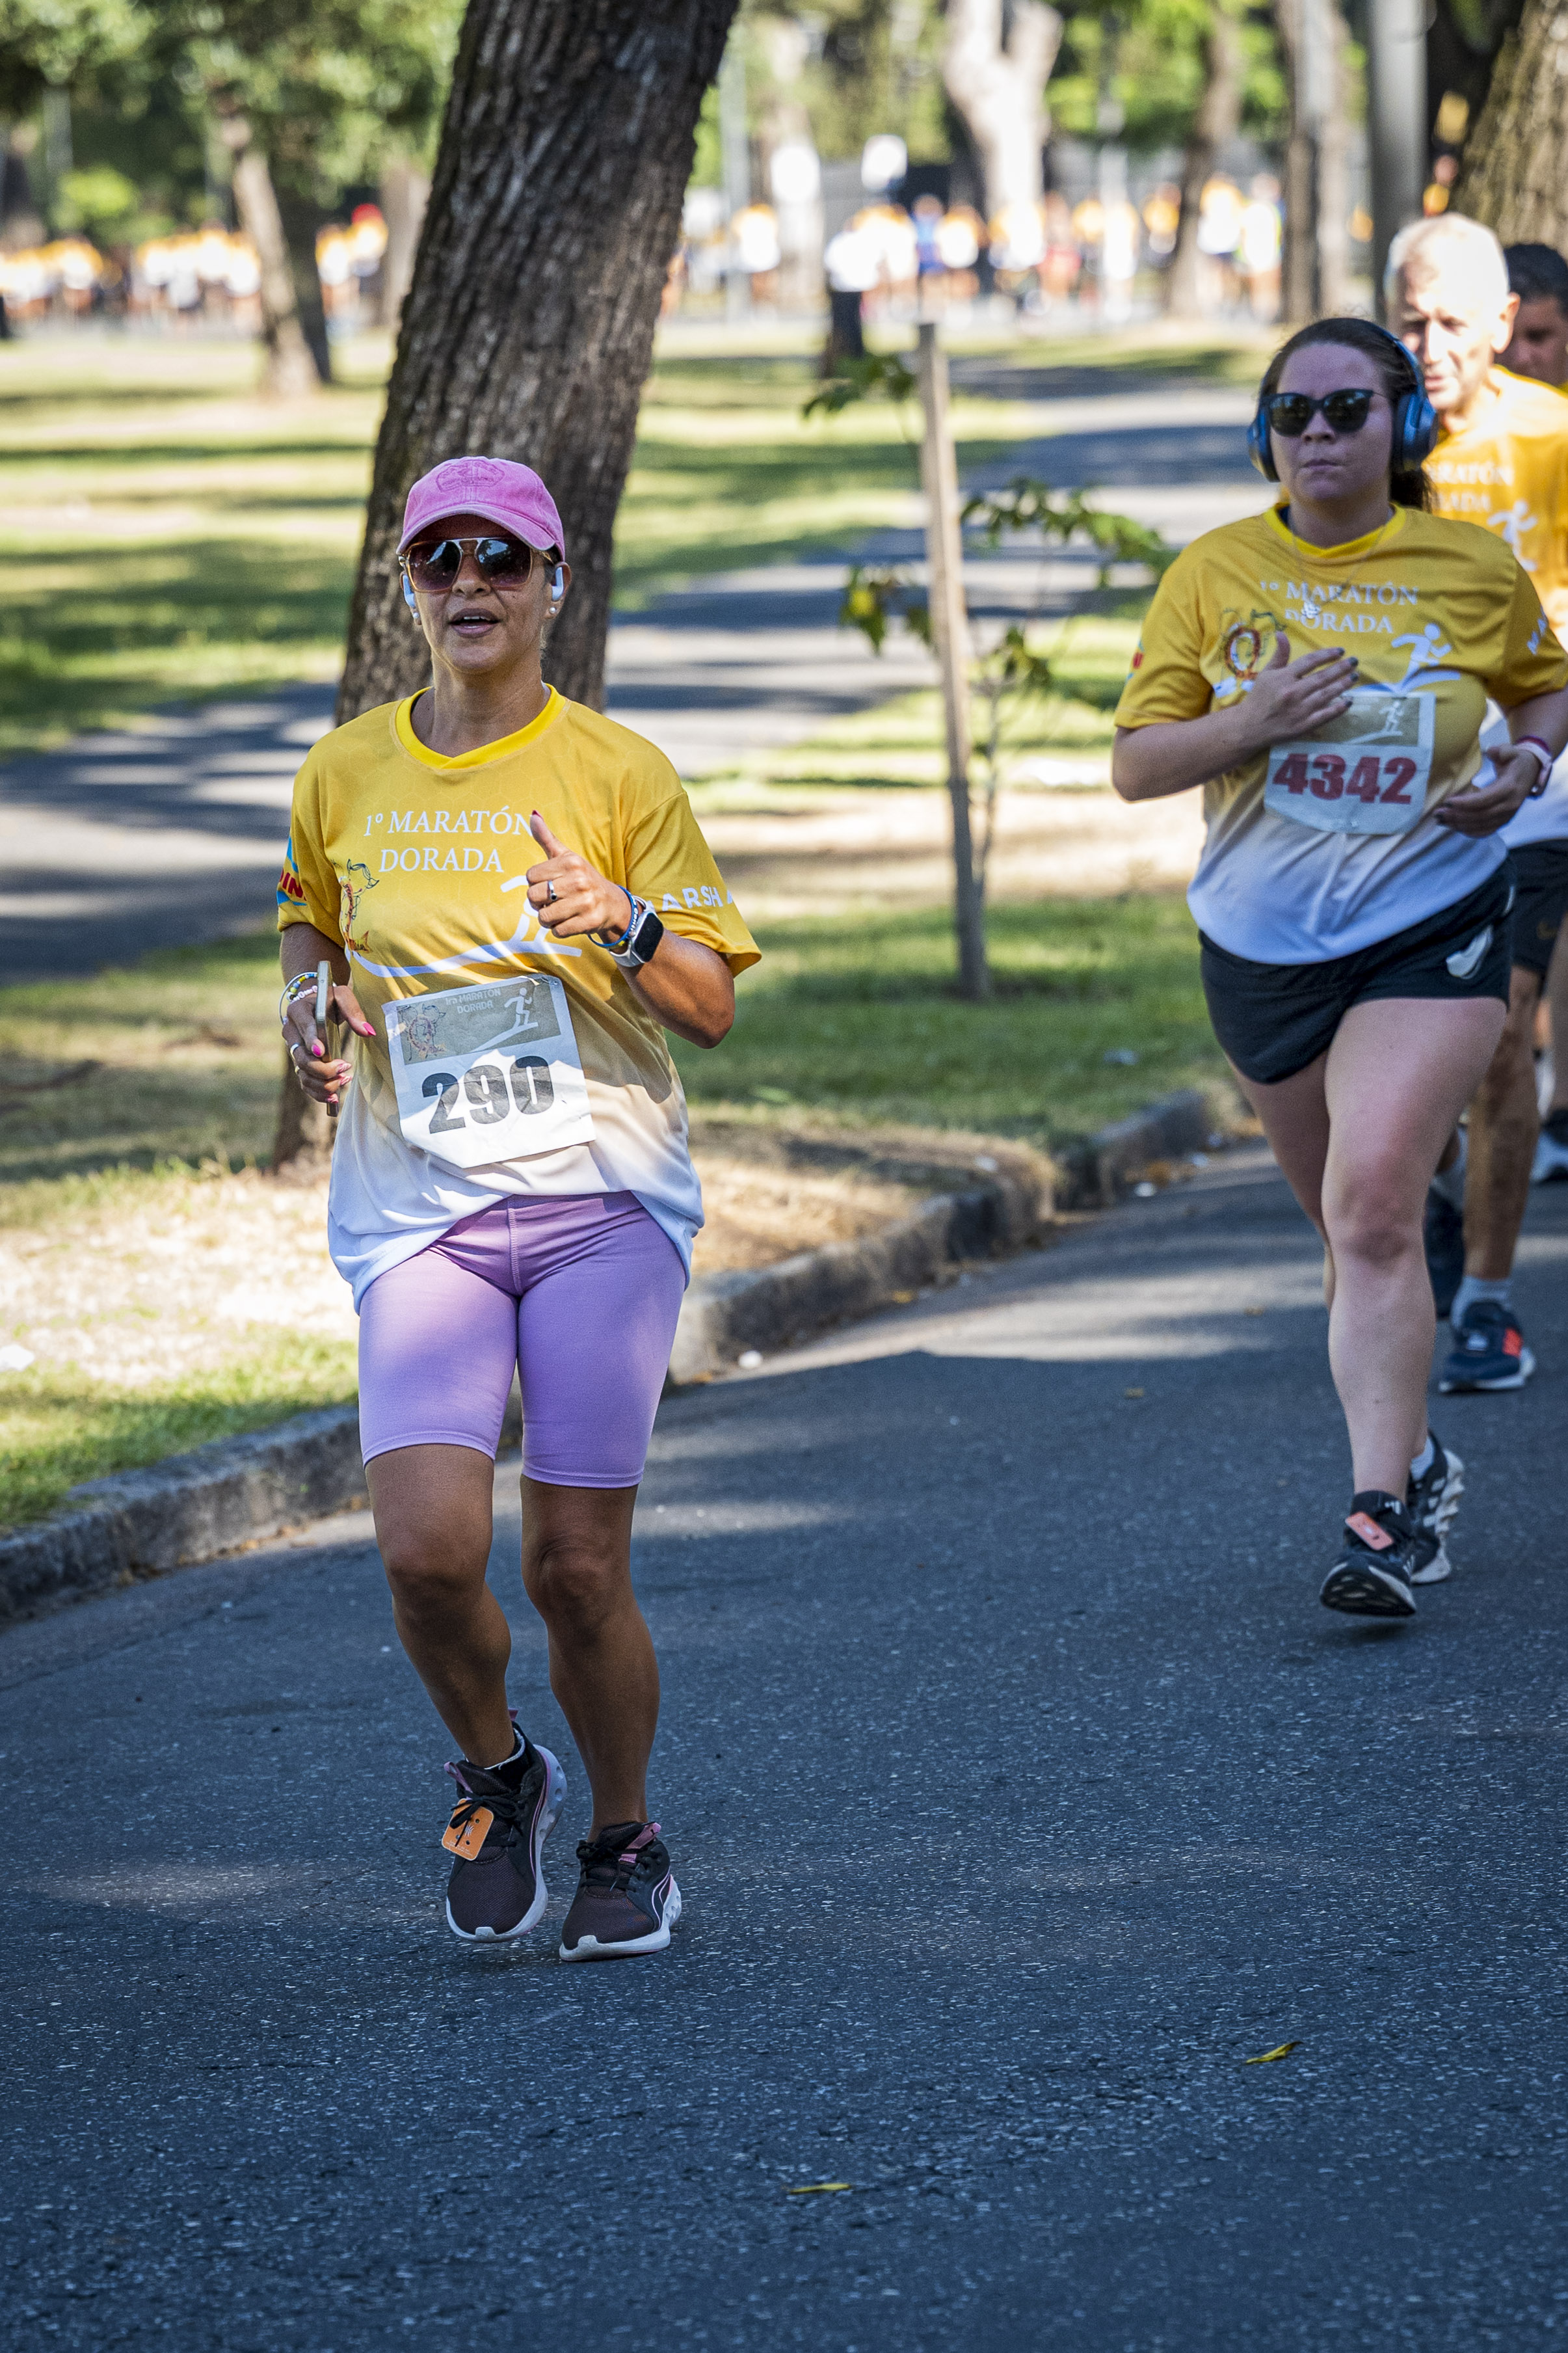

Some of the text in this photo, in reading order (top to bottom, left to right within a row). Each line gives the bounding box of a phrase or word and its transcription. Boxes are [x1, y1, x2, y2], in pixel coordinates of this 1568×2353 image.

[1273, 753, 1417, 804] 4342
[388, 805, 533, 837] MARATÓN
[379, 848, 504, 873] DORADA
[457, 1000, 493, 1014] DORADA
[421, 1055, 555, 1135] 290
